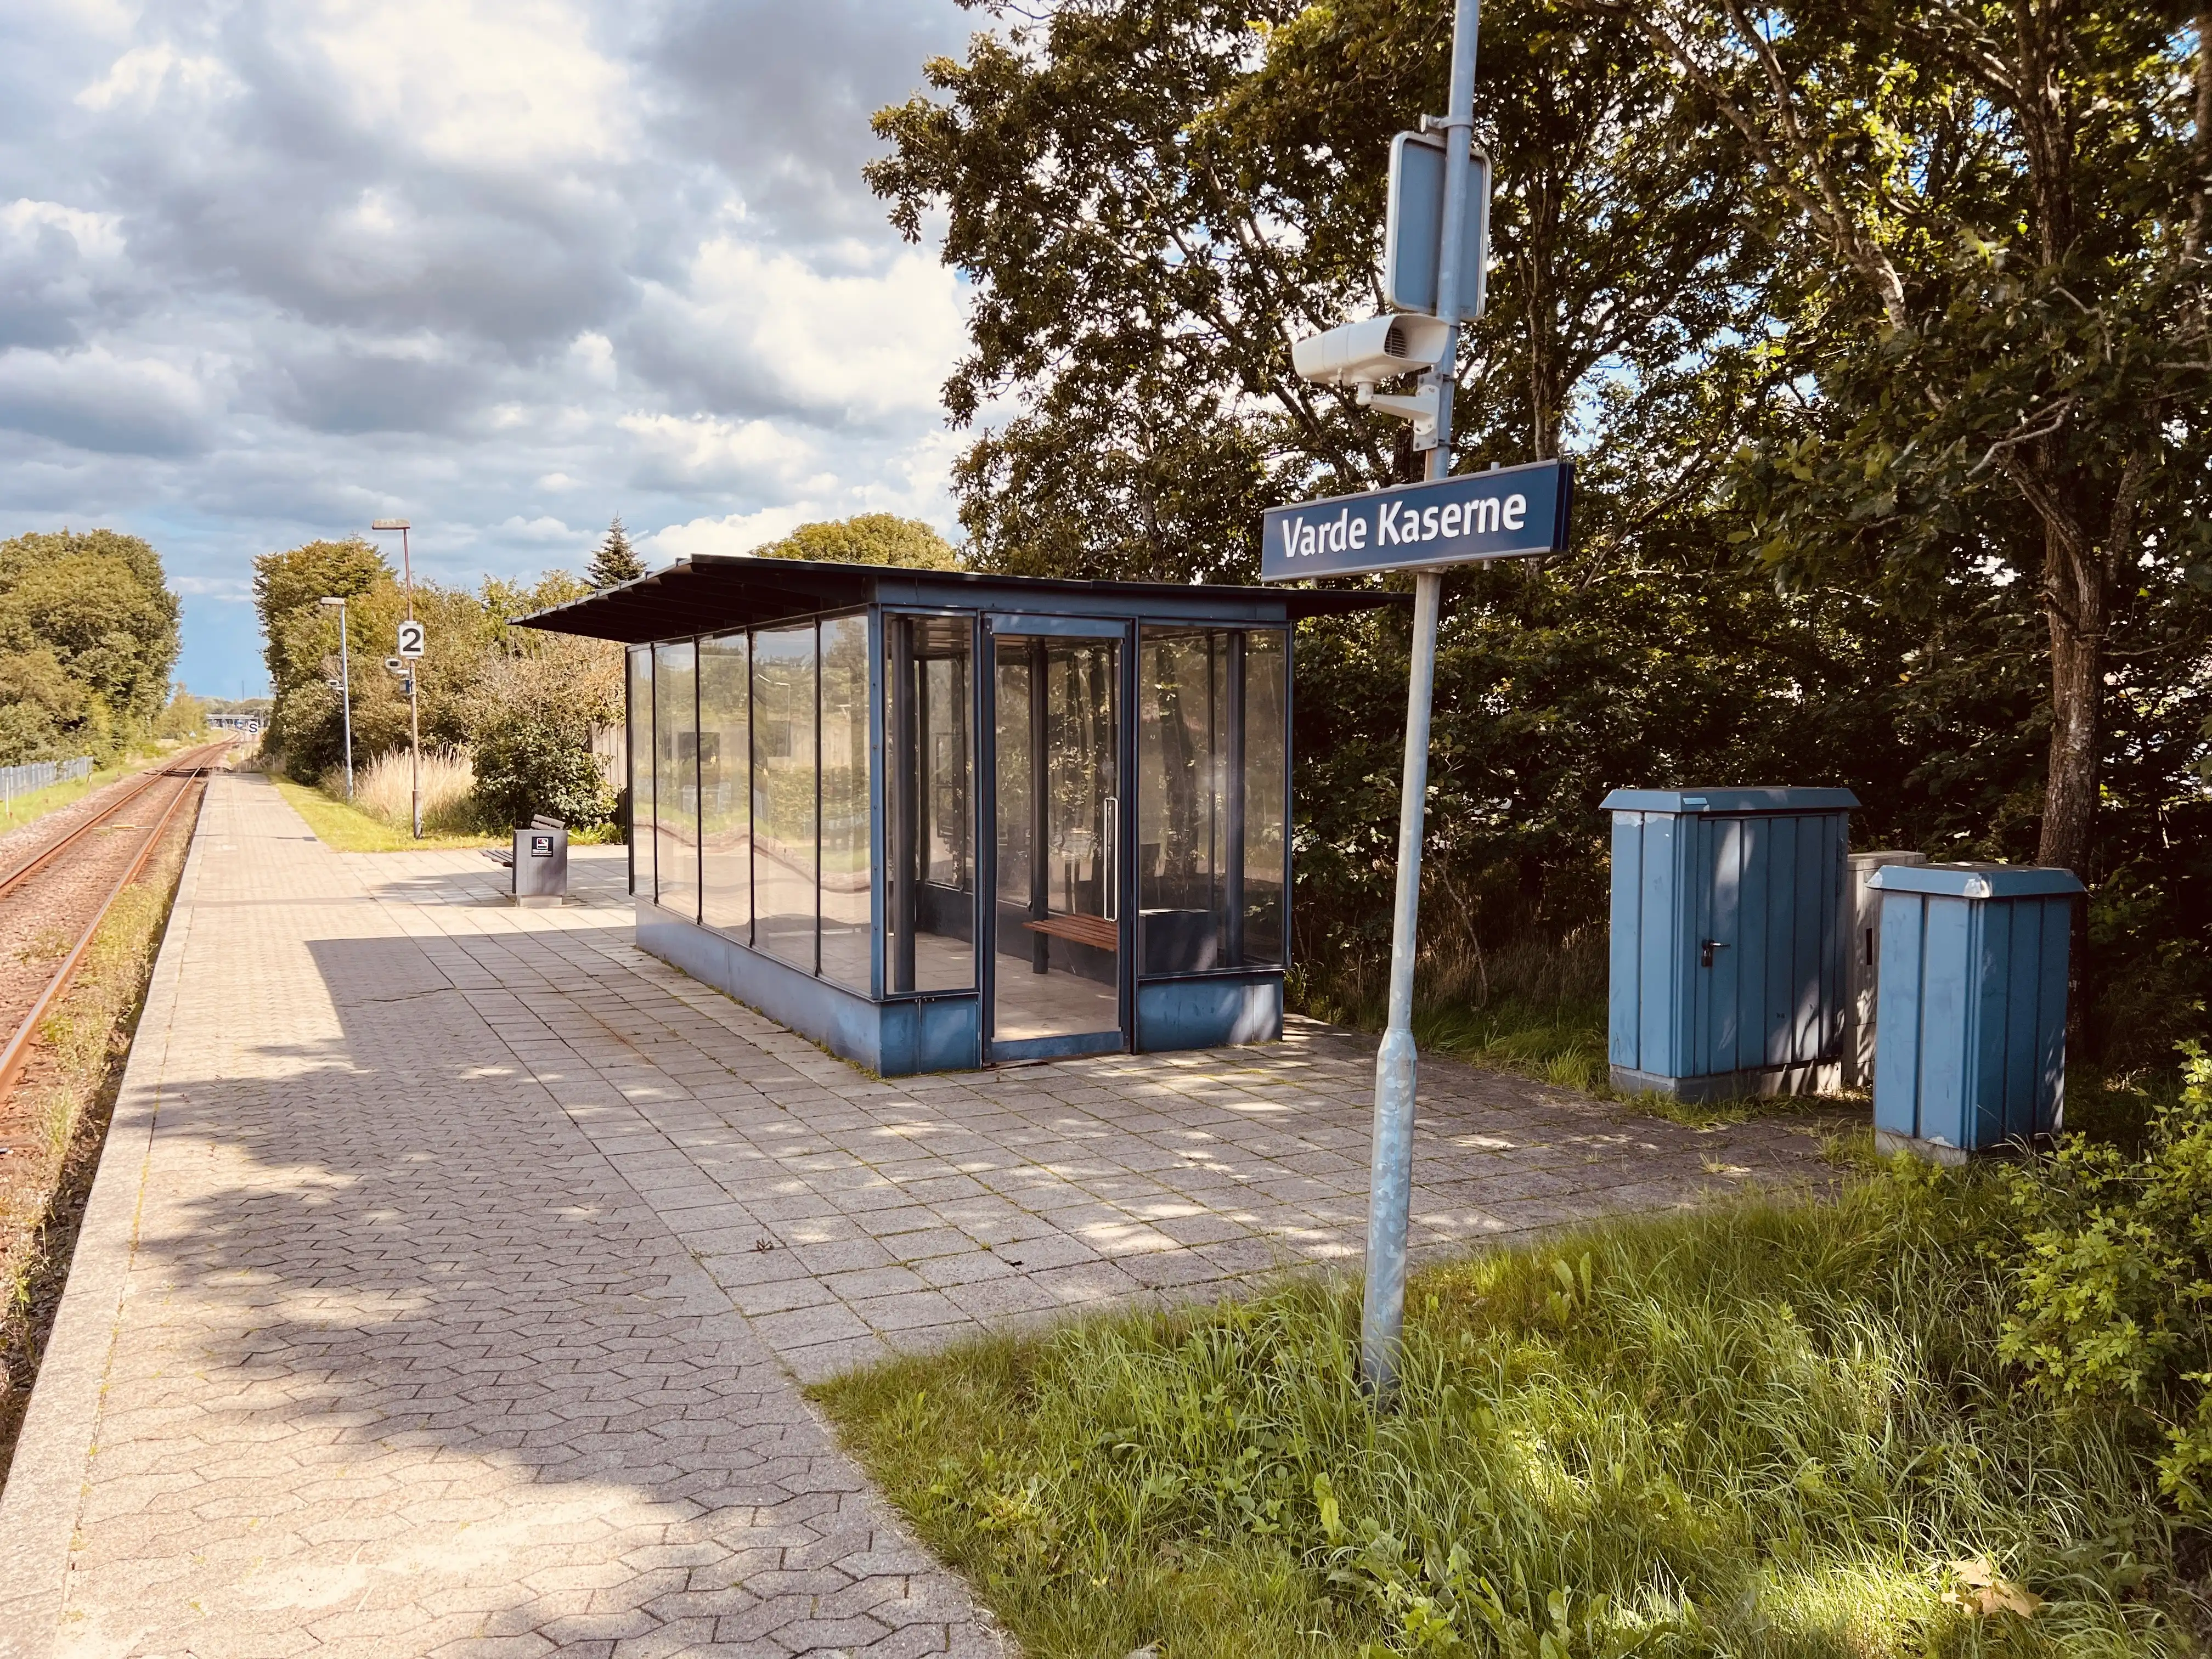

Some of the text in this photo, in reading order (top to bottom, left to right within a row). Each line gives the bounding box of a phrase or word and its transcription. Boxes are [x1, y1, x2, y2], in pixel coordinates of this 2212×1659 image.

[1282, 493, 1527, 558] Varde Kaserne
[402, 628, 421, 652] 2
[249, 723, 257, 733] S
